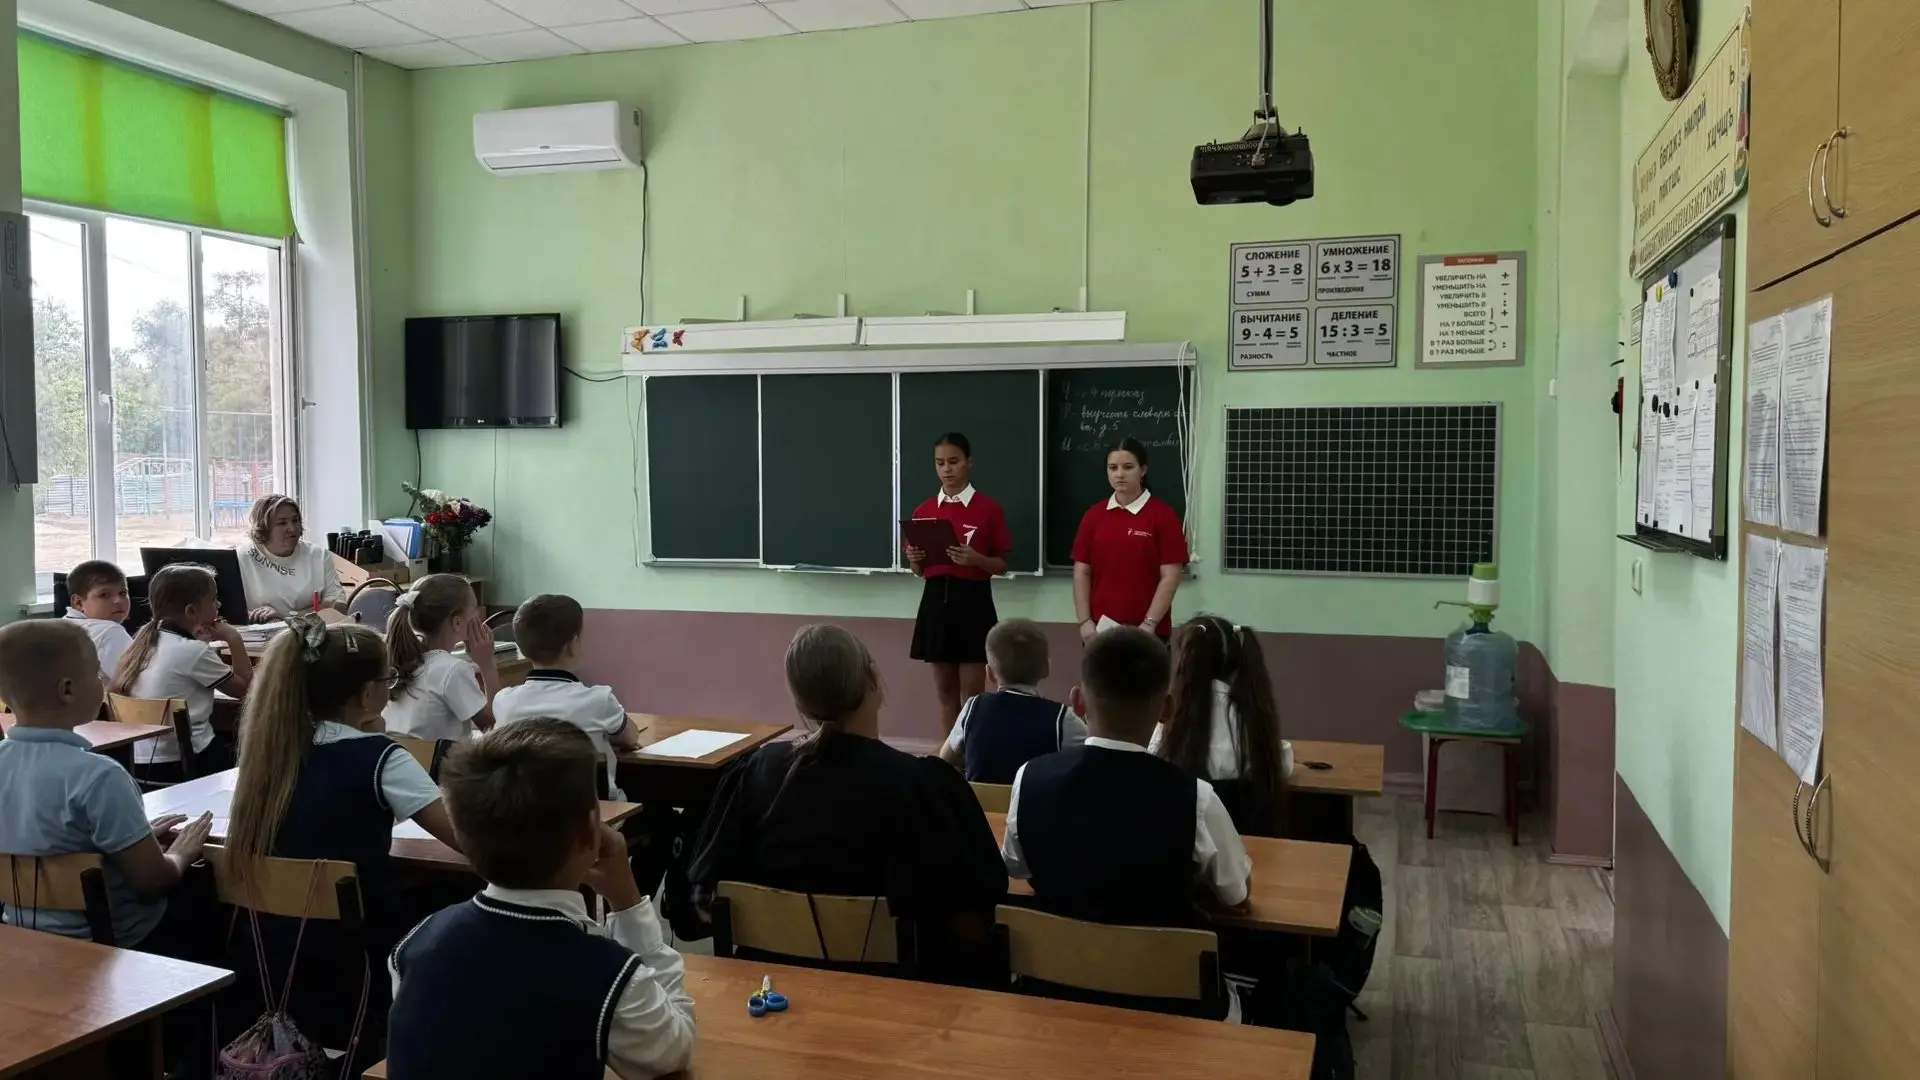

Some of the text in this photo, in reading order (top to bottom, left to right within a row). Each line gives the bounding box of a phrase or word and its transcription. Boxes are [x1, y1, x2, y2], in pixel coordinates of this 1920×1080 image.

[1245, 250, 1300, 261] СЛОЖЕНИЕ
[1323, 245, 1389, 257] УМНОЖЕНИЕ
[1241, 266, 1250, 278] 5
[1267, 264, 1276, 276] 3
[1293, 263, 1302, 276] 8
[1321, 262, 1330, 274] 6
[1344, 261, 1353, 273] 3
[1372, 258, 1391, 272] 18
[1246, 290, 1270, 298] СУММА
[1440, 292, 1480, 300] УВЕЛИЧИТЬ
[1240, 312, 1302, 324] ВЫЧИТАНИЕ
[1330, 310, 1379, 323] ДЕЛЕНИЕ
[1242, 328, 1251, 340] 9
[1263, 328, 1272, 340] 4
[1290, 326, 1298, 339] 5
[1320, 325, 1338, 338] 15
[1350, 324, 1360, 336] 3
[1378, 324, 1388, 336] 5
[1326, 350, 1357, 358] ЧАСТНОЕ
[1082, 404, 1128, 424] выучить
[248, 548, 296, 576] SUNRISE
